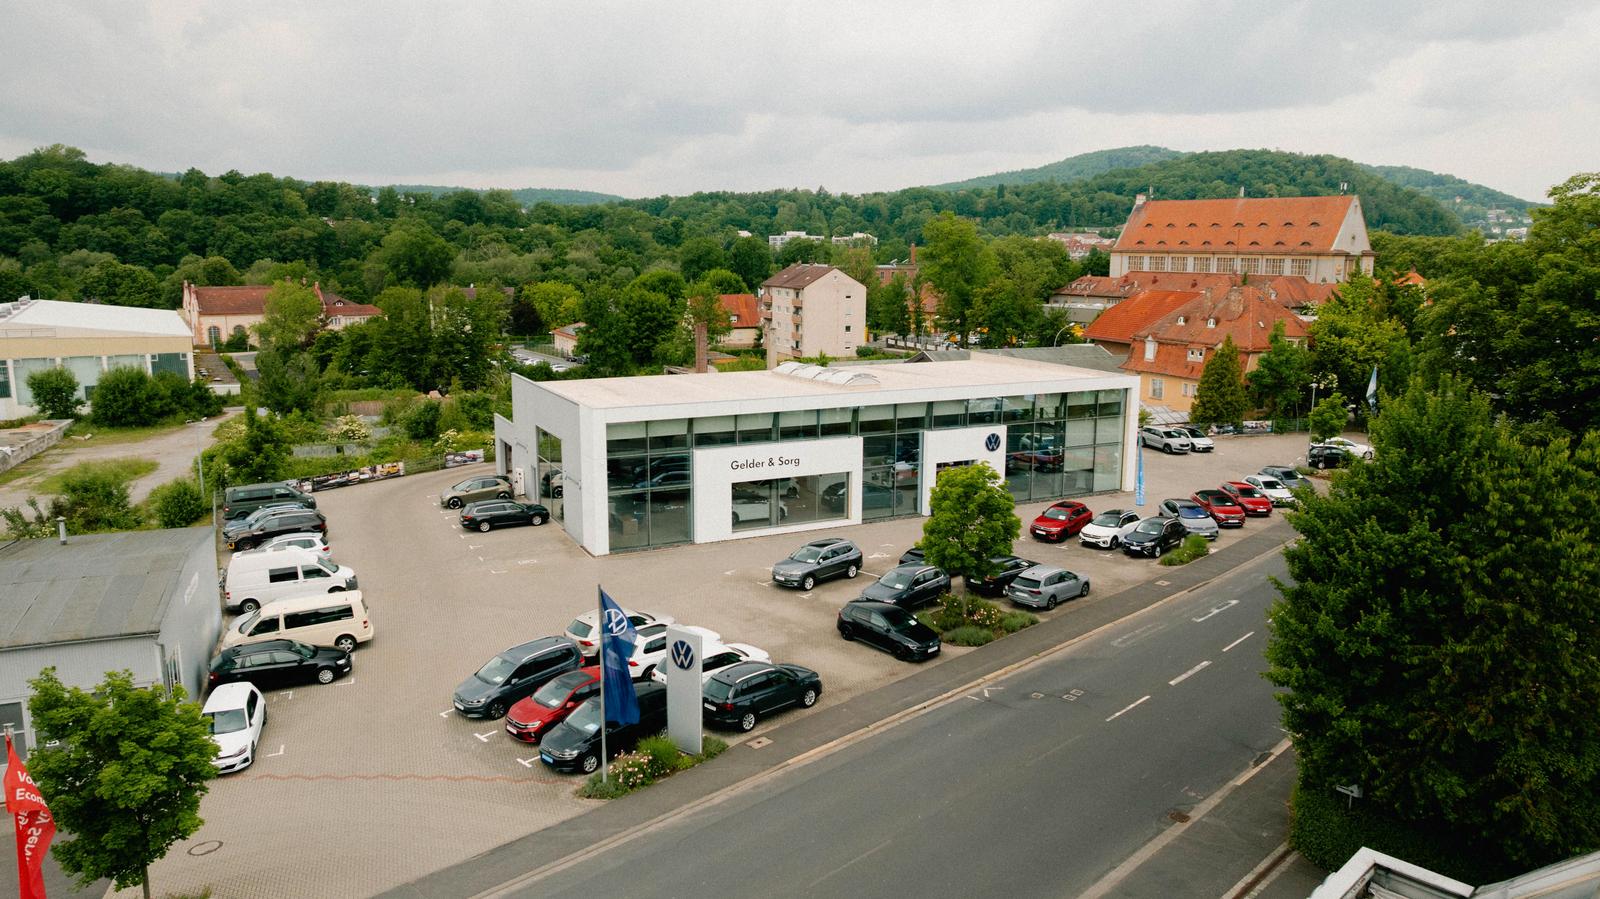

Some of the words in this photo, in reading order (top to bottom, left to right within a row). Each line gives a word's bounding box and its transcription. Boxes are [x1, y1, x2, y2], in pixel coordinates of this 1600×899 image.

[730, 459, 765, 470] Gelder
[767, 457, 775, 467] &
[778, 456, 800, 467] Sorg
[671, 640, 694, 670] VW
[17, 770, 37, 786] Vo
